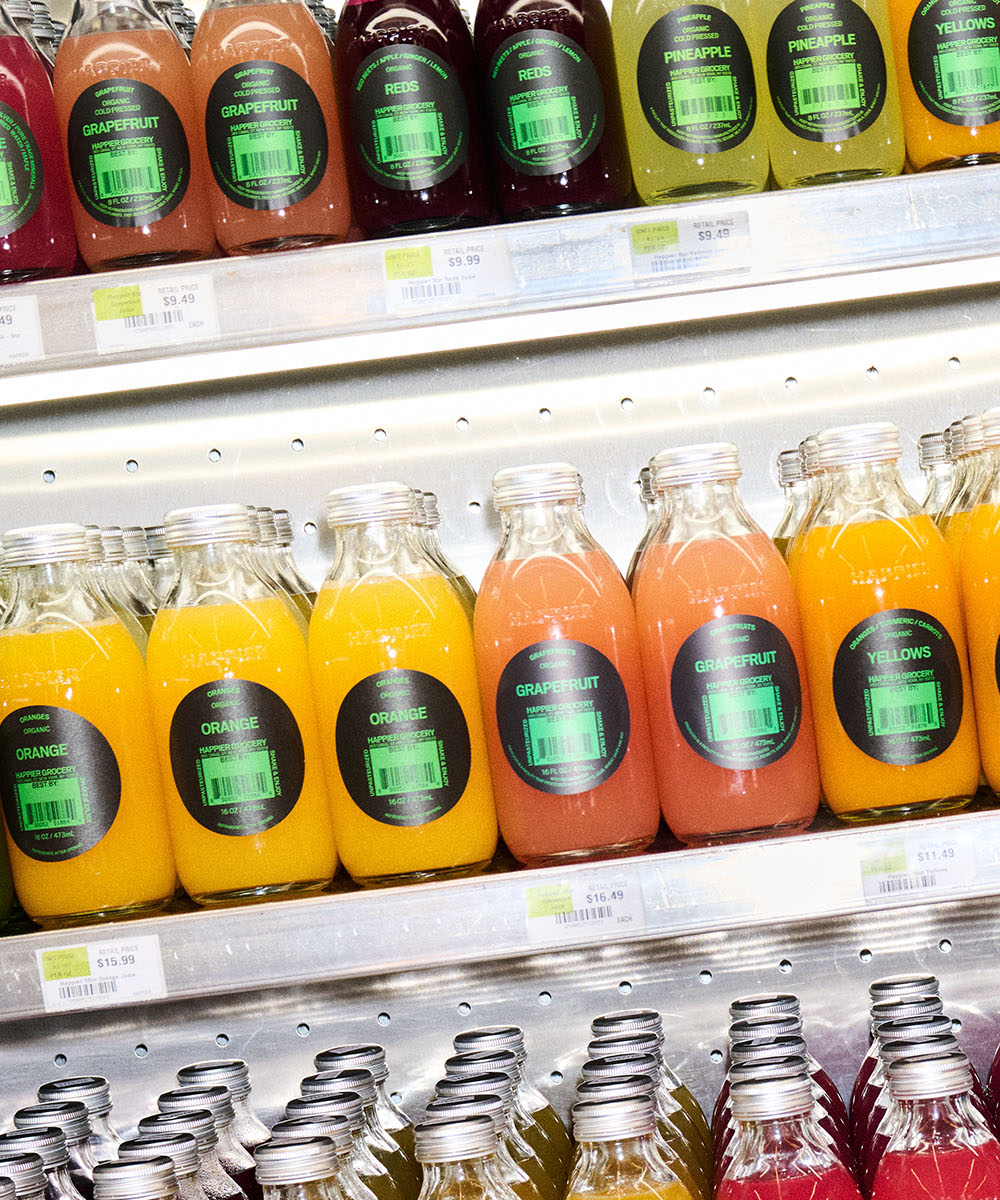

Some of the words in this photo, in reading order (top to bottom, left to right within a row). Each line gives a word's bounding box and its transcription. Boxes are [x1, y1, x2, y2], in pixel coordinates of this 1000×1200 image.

[935, 17, 995, 34] YELLOWS
[788, 33, 856, 52] PINEAPPLE
[664, 46, 731, 63] PINEAPPLE
[379, 53, 399, 64] APPLE
[404, 53, 426, 64] GINGER
[428, 59, 448, 80] LEMON
[518, 65, 552, 81] REDS
[242, 80, 269, 88] ORGANIC
[385, 80, 419, 95] REDS
[221, 99, 298, 118] GRAPEFRUIT
[82, 117, 159, 137] GRAPEFRUIT
[230, 121, 259, 132] HAPPIER
[261, 118, 292, 129] GROCERY
[698, 228, 730, 241] $9.49
[448, 254, 480, 267] $9.99
[163, 294, 195, 306] $9.49
[695, 651, 776, 673] GRAPEFRUIT
[867, 646, 931, 664] YELLOWS
[516, 676, 599, 697] GRAPEFRUIT
[201, 716, 258, 735] ORANGE
[15, 743, 69, 760] ORANGE
[917, 849, 955, 861] $11.49
[586, 890, 624, 903] $16.49
[97, 955, 135, 968] $15.99
